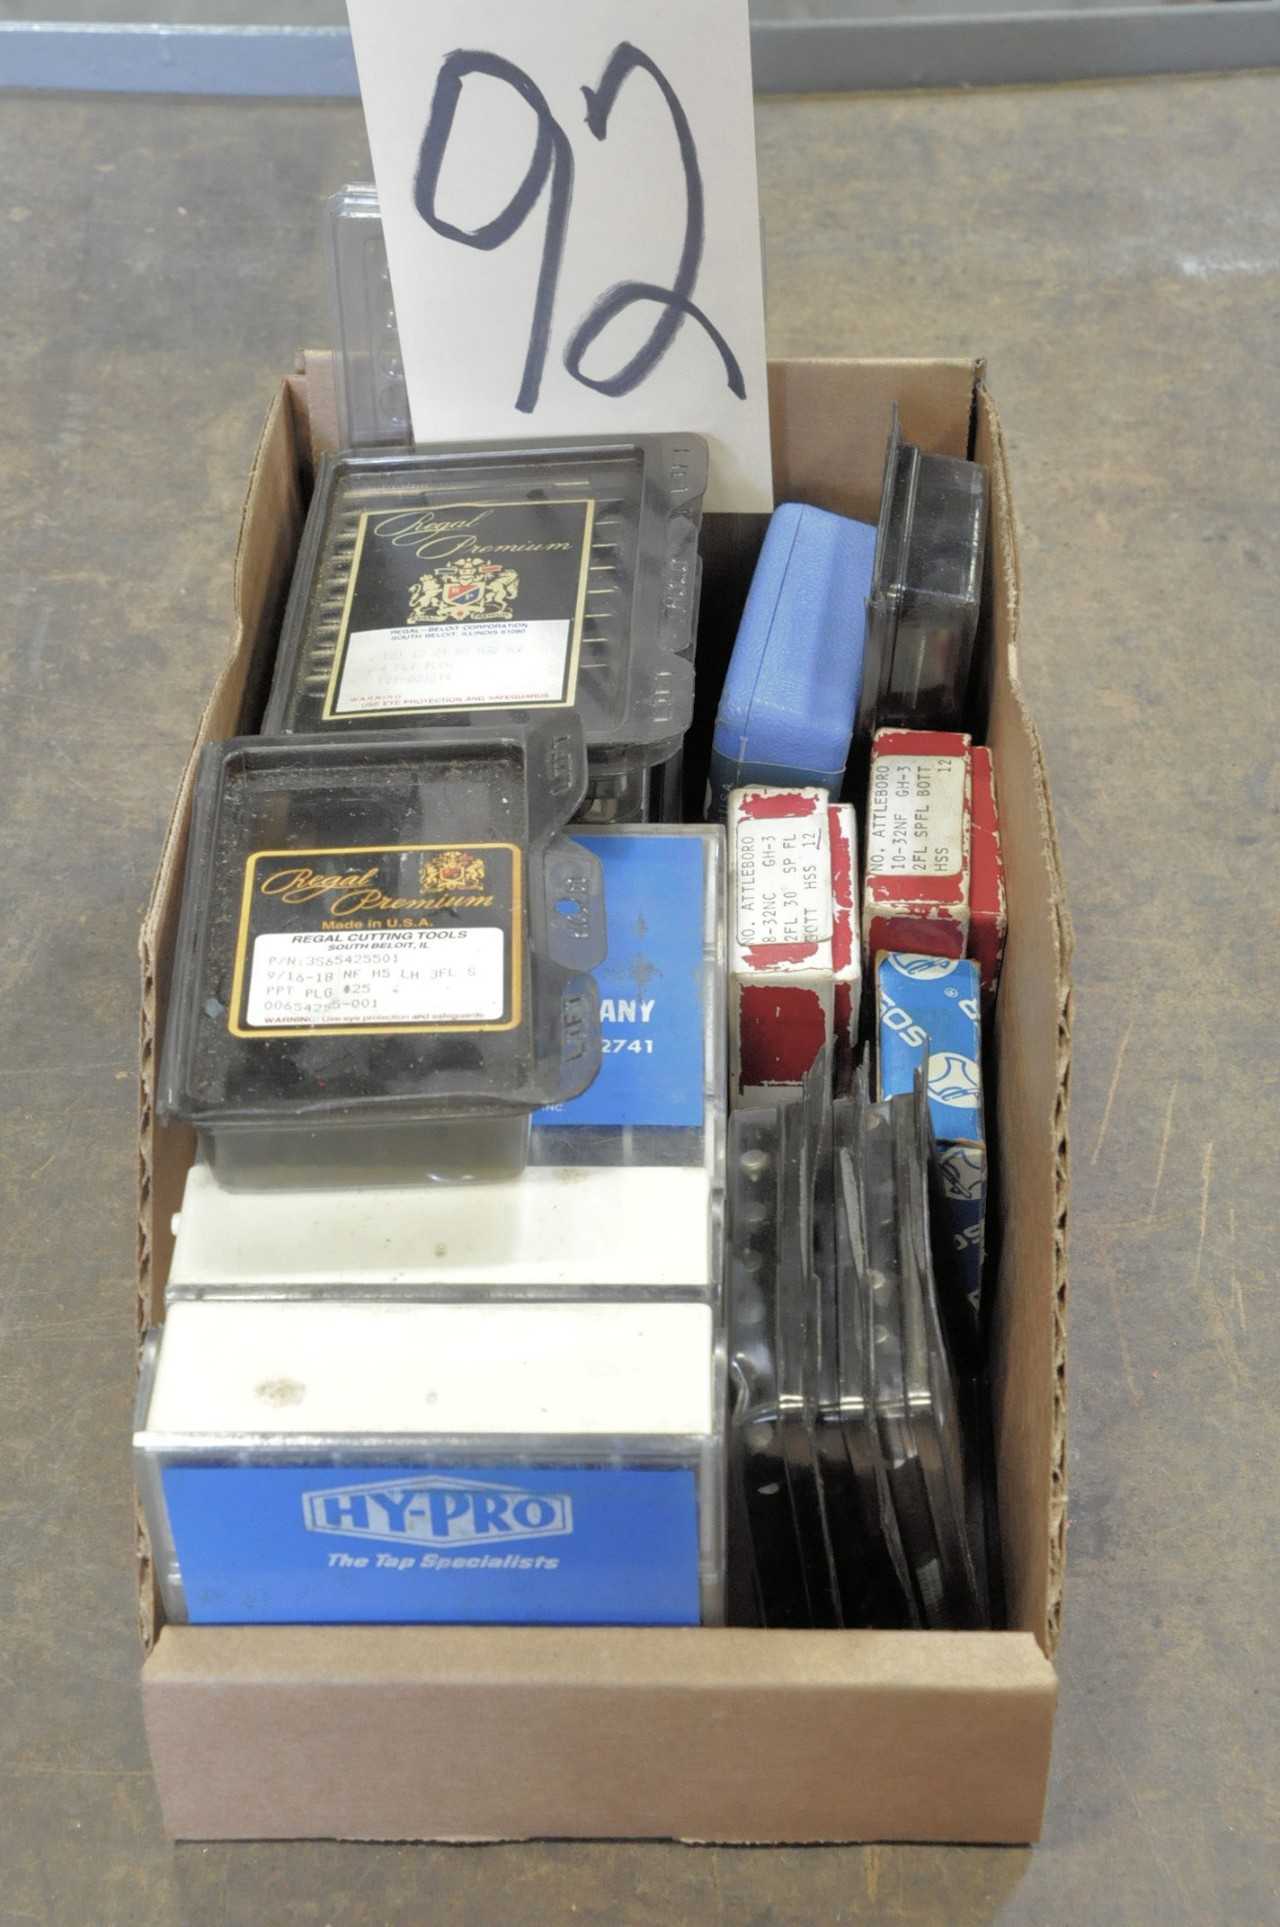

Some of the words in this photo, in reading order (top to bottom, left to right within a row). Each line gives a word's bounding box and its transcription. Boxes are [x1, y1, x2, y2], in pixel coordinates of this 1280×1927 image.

[413, 40, 747, 414] 92
[374, 510, 495, 547] Regal
[416, 535, 573, 559] Premium
[937, 759, 952, 772] 12
[896, 766, 911, 797] GH-3
[916, 766, 931, 797] BOTT
[872, 765, 890, 838] ATTLEBORO
[914, 805, 930, 838] SPFL
[761, 836, 776, 867] GH-3
[783, 833, 797, 849] FL
[801, 832, 816, 847] 12
[891, 814, 908, 870] 10-32NF
[783, 858, 797, 874] SP
[870, 848, 886, 872] NO.
[912, 846, 928, 871] 2FL
[934, 848, 949, 872] HSS
[261, 867, 379, 904] Regal
[741, 836, 755, 911] ATTLEBORO
[803, 865, 817, 889] HSS
[331, 889, 493, 916] Premium
[321, 920, 362, 930] Made
[367, 919, 382, 929] in
[386, 918, 433, 928] U.S.A.
[762, 892, 778, 943] 8-32NC
[784, 917, 798, 941] 2FL
[292, 934, 343, 944] REGAL
[347, 931, 413, 942] CUTTING
[418, 930, 468, 940] TOOLS
[741, 922, 755, 944] NO.
[328, 943, 369, 951] SOUTH
[267, 971, 334, 983] 9/16-18
[343, 970, 360, 979] NF
[400, 969, 420, 980] LH
[266, 985, 295, 996] PPT
[305, 987, 333, 999] PLG
[363, 1014, 411, 1022] protection
[413, 1012, 430, 1020] and
[600, 999, 656, 1023] ANY
[600, 1039, 654, 1054] 2741
[321, 1489, 556, 1537] HY-PRO
[327, 1553, 369, 1568] The
[374, 1553, 416, 1570] Tap
[420, 1553, 560, 1570] Specialists
